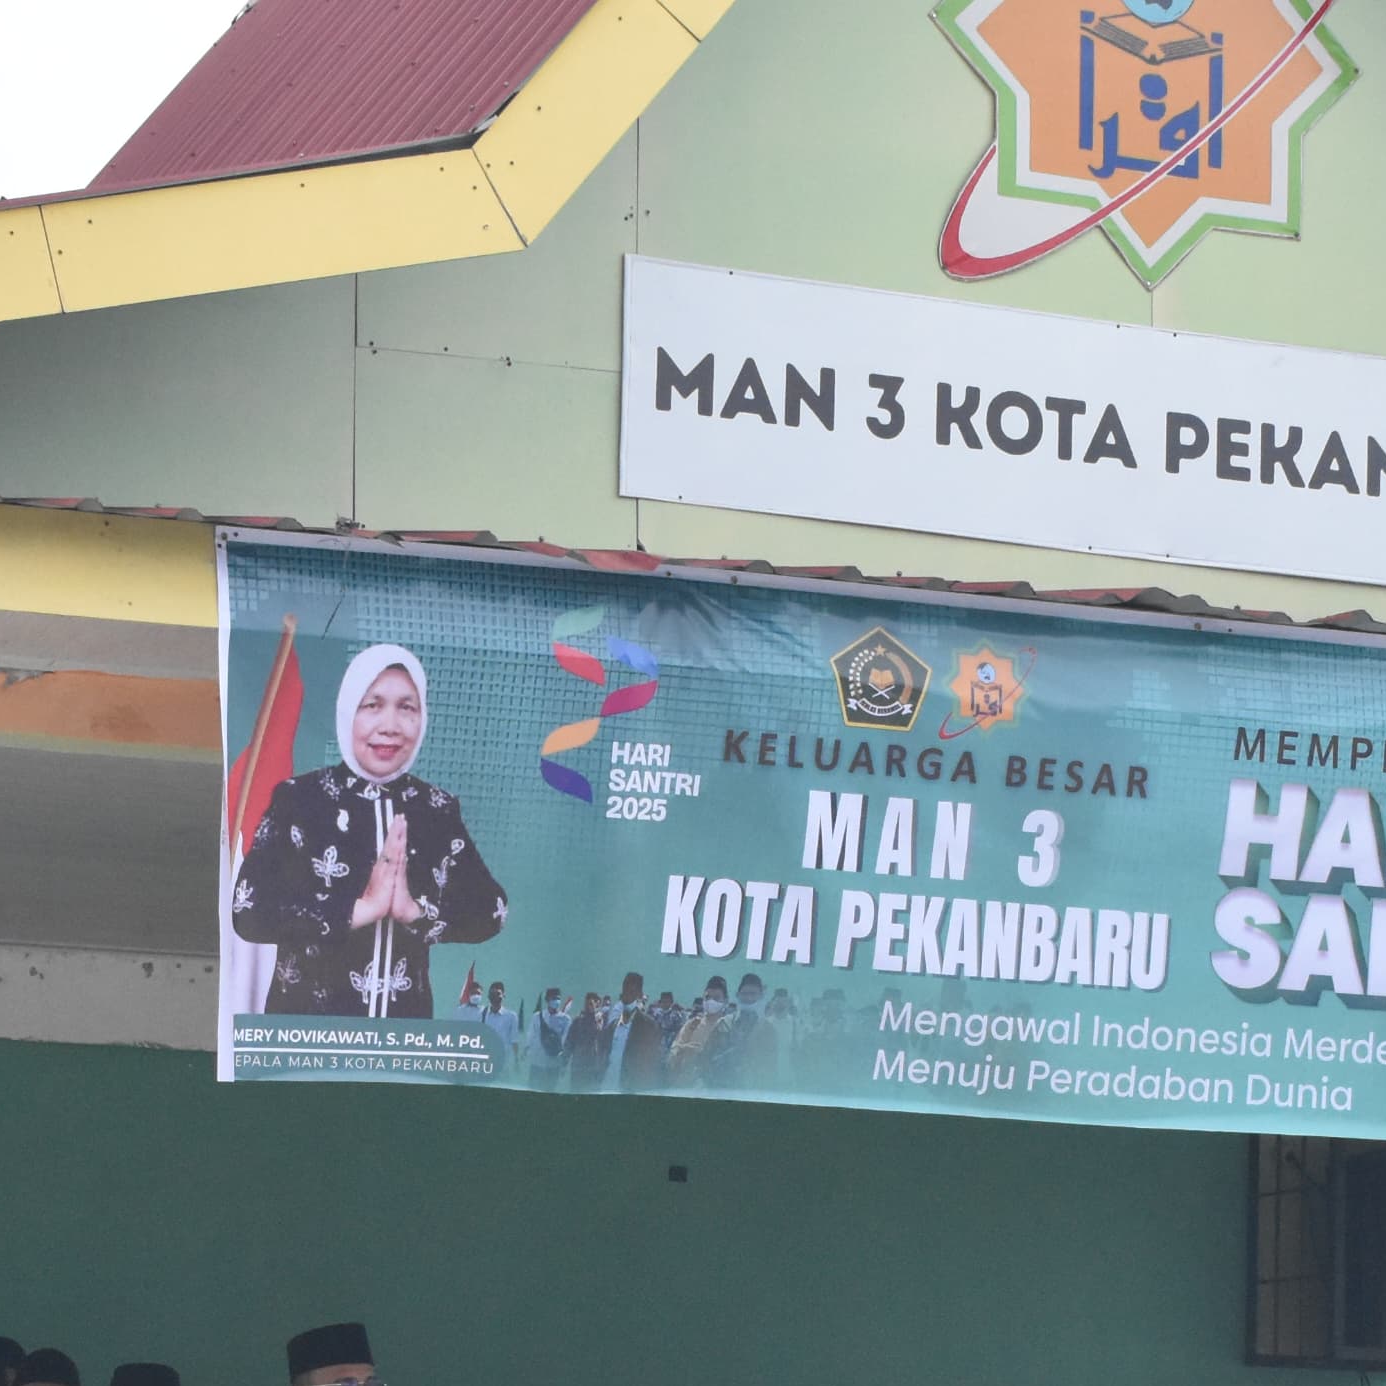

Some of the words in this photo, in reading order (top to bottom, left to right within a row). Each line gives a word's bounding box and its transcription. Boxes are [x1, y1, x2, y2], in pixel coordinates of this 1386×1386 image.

[653, 345, 835, 432] MAN
[865, 372, 906, 441] 3
[934, 380, 1139, 470] KOTA
[608, 768, 702, 797] SANTRI
[611, 741, 672, 768] HARI
[722, 728, 978, 785] KELUARGA
[1005, 754, 1150, 799] BESAR
[605, 796, 668, 822] 2025
[801, 788, 973, 881] MAN
[1016, 808, 1066, 889] 3
[660, 874, 816, 966] KOTA
[832, 889, 1172, 993] PEKANBARU
[233, 1028, 274, 1043] MERY
[277, 1028, 382, 1048] NOVIKAWATI,
[386, 1033, 401, 1046] S.
[404, 1033, 432, 1049] Pd.,
[436, 1034, 454, 1048] M.
[458, 1035, 485, 1050] Pd.
[877, 1000, 1080, 1048] Mengawal
[1091, 1015, 1273, 1059] Indonesia
[287, 1056, 324, 1069] MAN
[329, 1057, 339, 1070] 3
[345, 1057, 386, 1071] KOTA
[391, 1058, 494, 1075] PEKANBARU
[871, 1048, 1015, 1096] Menuju
[1026, 1059, 1234, 1105] Peradaban
[1244, 1072, 1353, 1112] Dunia
